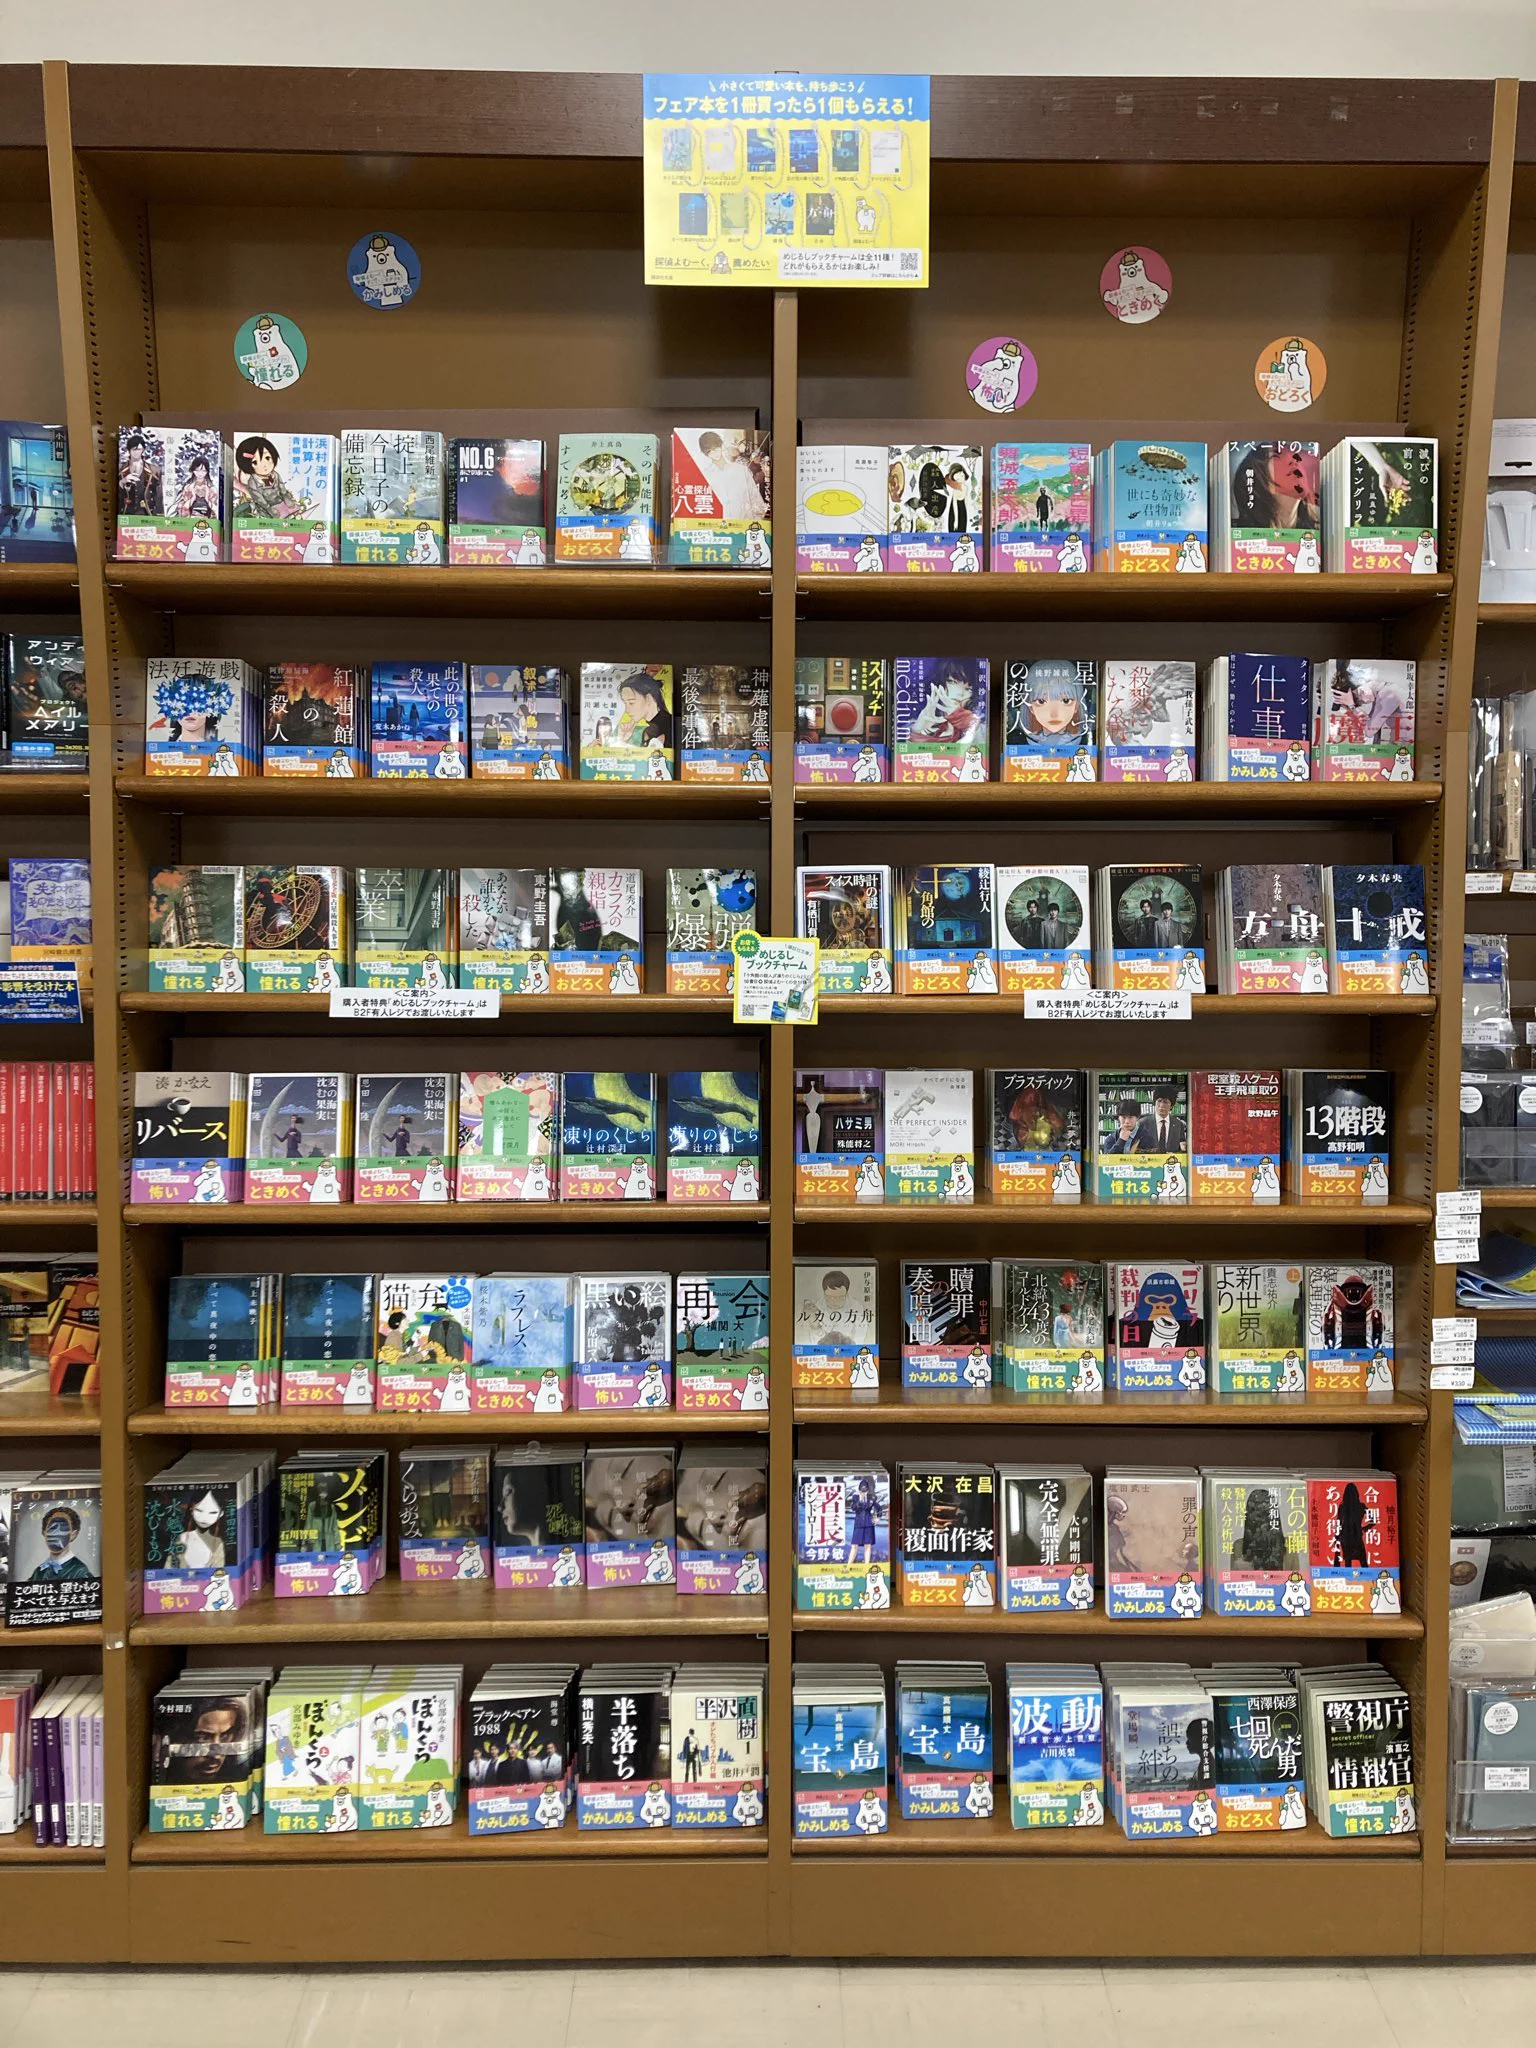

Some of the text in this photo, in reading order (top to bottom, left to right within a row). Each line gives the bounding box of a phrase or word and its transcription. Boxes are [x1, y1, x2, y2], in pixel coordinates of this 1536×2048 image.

[720, 81, 854, 92] 小さくて可愛い本を、持ち歩こう
[733, 258, 770, 267] 薦めたい
[364, 285, 412, 301] かみしめる
[1118, 297, 1161, 317] ときめく
[255, 364, 294, 382] 憧れる
[981, 384, 1008, 404] 怖い
[1264, 389, 1309, 403] おどろく
[303, 437, 314, 499] 計算ノート
[315, 438, 327, 490] 浜村渚の
[345, 433, 365, 498] 備忘録
[393, 434, 416, 477] 掟上
[460, 446, 495, 470] NO.6
[1403, 447, 1413, 471] 前の
[1418, 447, 1429, 485] 滅びの
[370, 433, 391, 513] 今日子の
[640, 444, 653, 515] その可能性
[674, 484, 712, 495] 心霊探偵
[1127, 487, 1198, 503] 世にも奇妙な
[1353, 455, 1363, 524] シャングリラ
[674, 494, 714, 514] 八雲
[1143, 502, 1182, 517] 君物語
[121, 544, 175, 560] ときめく
[355, 546, 399, 563] 憧れる
[688, 546, 732, 562] 憧れる
[1120, 557, 1171, 573] おどろく
[1352, 555, 1402, 571] ときめく
[148, 660, 240, 681] 法廷遊戯
[409, 667, 424, 695] 殺人
[426, 672, 440, 712] 果ての
[868, 661, 882, 716] スイッチ
[896, 659, 911, 741] medium
[1007, 663, 1034, 734] の殺人
[1072, 661, 1097, 736] 星くず
[269, 695, 290, 743] 殺人
[303, 706, 319, 721] の
[333, 667, 354, 745] 紅蓮館
[681, 667, 701, 750] 最後の事件
[751, 668, 770, 746] 神薙虚無
[902, 769, 951, 782] ときめく
[588, 871, 607, 910] 親指
[824, 874, 878, 887] スイス時計
[978, 867, 990, 913] 綾辻行人
[1356, 872, 1403, 883] 夕木春央
[480, 878, 496, 916] 誰かを
[496, 872, 509, 914] あなたが
[533, 874, 547, 926] 東野圭吾
[608, 871, 623, 927] カラスの
[625, 873, 636, 916] 道尾秀介
[462, 894, 481, 938] 殺した
[1234, 909, 1325, 942] 方舟
[1336, 907, 1426, 942] 十戒
[746, 960, 808, 970] ブックチャーム
[758, 950, 794, 960] めじるし
[163, 975, 206, 990] 憧れる
[472, 976, 514, 992] 憧れる
[912, 977, 961, 990] おどろく
[1241, 976, 1290, 990] ときめく
[342, 998, 487, 1008] 購入者特典「めじるしブックチャーム」は
[354, 1008, 475, 1017] B2F有人レジでお渡しいたします
[1036, 1000, 1179, 1009] 購入者特典「めじるしブックチャーム」は
[1048, 1010, 1167, 1018] B2F有人レジでお渡しいたします
[155, 1076, 212, 1090] 湊かなえ
[1004, 1075, 1074, 1090] プラスティック
[1207, 1074, 1279, 1085] 密室殺人ゲーム
[1215, 1085, 1279, 1096] 王手飛車取り
[316, 1078, 327, 1120] 沈む果実
[327, 1078, 337, 1120] 麦の海に
[835, 1116, 873, 1130] ハサミ男
[1248, 1109, 1279, 1118] 歌野晶午
[1305, 1105, 1386, 1138] 13階段
[135, 1117, 228, 1145] リバース
[563, 1126, 651, 1144] 凍りのくじら
[586, 1144, 627, 1153] 辻村深月
[1327, 1142, 1365, 1152] 高野和明
[250, 1184, 301, 1199] ときめく
[803, 1179, 850, 1192] おどろく
[1310, 1180, 1356, 1194] おどろく
[584, 1282, 666, 1309] 黒い絵
[677, 1280, 770, 1320] 再会
[949, 1268, 975, 1318] 贖罪
[1182, 1265, 1201, 1327] ゴリラ
[1217, 1268, 1235, 1315] より
[1267, 1268, 1278, 1308] 貴志祐介
[796, 1310, 874, 1323] ルカの方舟
[908, 1267, 935, 1345] 奏鳴曲
[1019, 1271, 1030, 1334] コールドケース
[1031, 1273, 1050, 1345] 北緯43度の
[1120, 1268, 1140, 1343] 裁判の日
[1236, 1265, 1263, 1342] 新世界
[511, 1289, 528, 1347] ラブレス
[979, 1300, 988, 1335] 中山七里
[909, 1371, 958, 1383] かみしめる
[595, 1390, 624, 1404] 怖い
[805, 1484, 817, 1546] シンドローム
[817, 1485, 845, 1545] 署長
[1181, 1496, 1198, 1543] 罪の声
[1221, 1487, 1234, 1555] 殺人分析班
[1235, 1487, 1247, 1528] 警視庁
[1268, 1487, 1280, 1531] 麻見和史
[1285, 1486, 1309, 1554] 石の繭
[1506, 1504, 1532, 1512] LUDDITE
[1038, 1480, 1060, 1566] 完全無罪
[1325, 1486, 1344, 1565] あり得ない
[1363, 1486, 1382, 1565] 合理的に
[904, 1527, 994, 1553] 覆面作家
[14, 1582, 100, 1596] この町は、望むもの
[290, 1577, 319, 1594] 怖い
[909, 1589, 957, 1603] おどろく
[14, 1594, 99, 1608] すべてを与えます
[472, 1708, 542, 1724] ブラックペアン
[1012, 1696, 1102, 1736] 波動
[1247, 1696, 1298, 1711] 西澤保彦
[1326, 1699, 1410, 1735] 警視庁
[304, 1699, 329, 1768] ぼんくら
[412, 1695, 440, 1763] ぼんくら
[473, 1723, 501, 1736] 1988
[582, 1697, 594, 1745] 横山秀夫
[610, 1696, 638, 1780] 半落ち
[908, 1722, 985, 1756] 宝島
[799, 1739, 880, 1774] 宝島
[1040, 1748, 1076, 1758] 吉川英梨
[1330, 1755, 1413, 1789] 情報官
[162, 1814, 204, 1829] 憧れる
[582, 1811, 635, 1825] かみしめる
[1131, 1822, 1184, 1835] かみしめる
